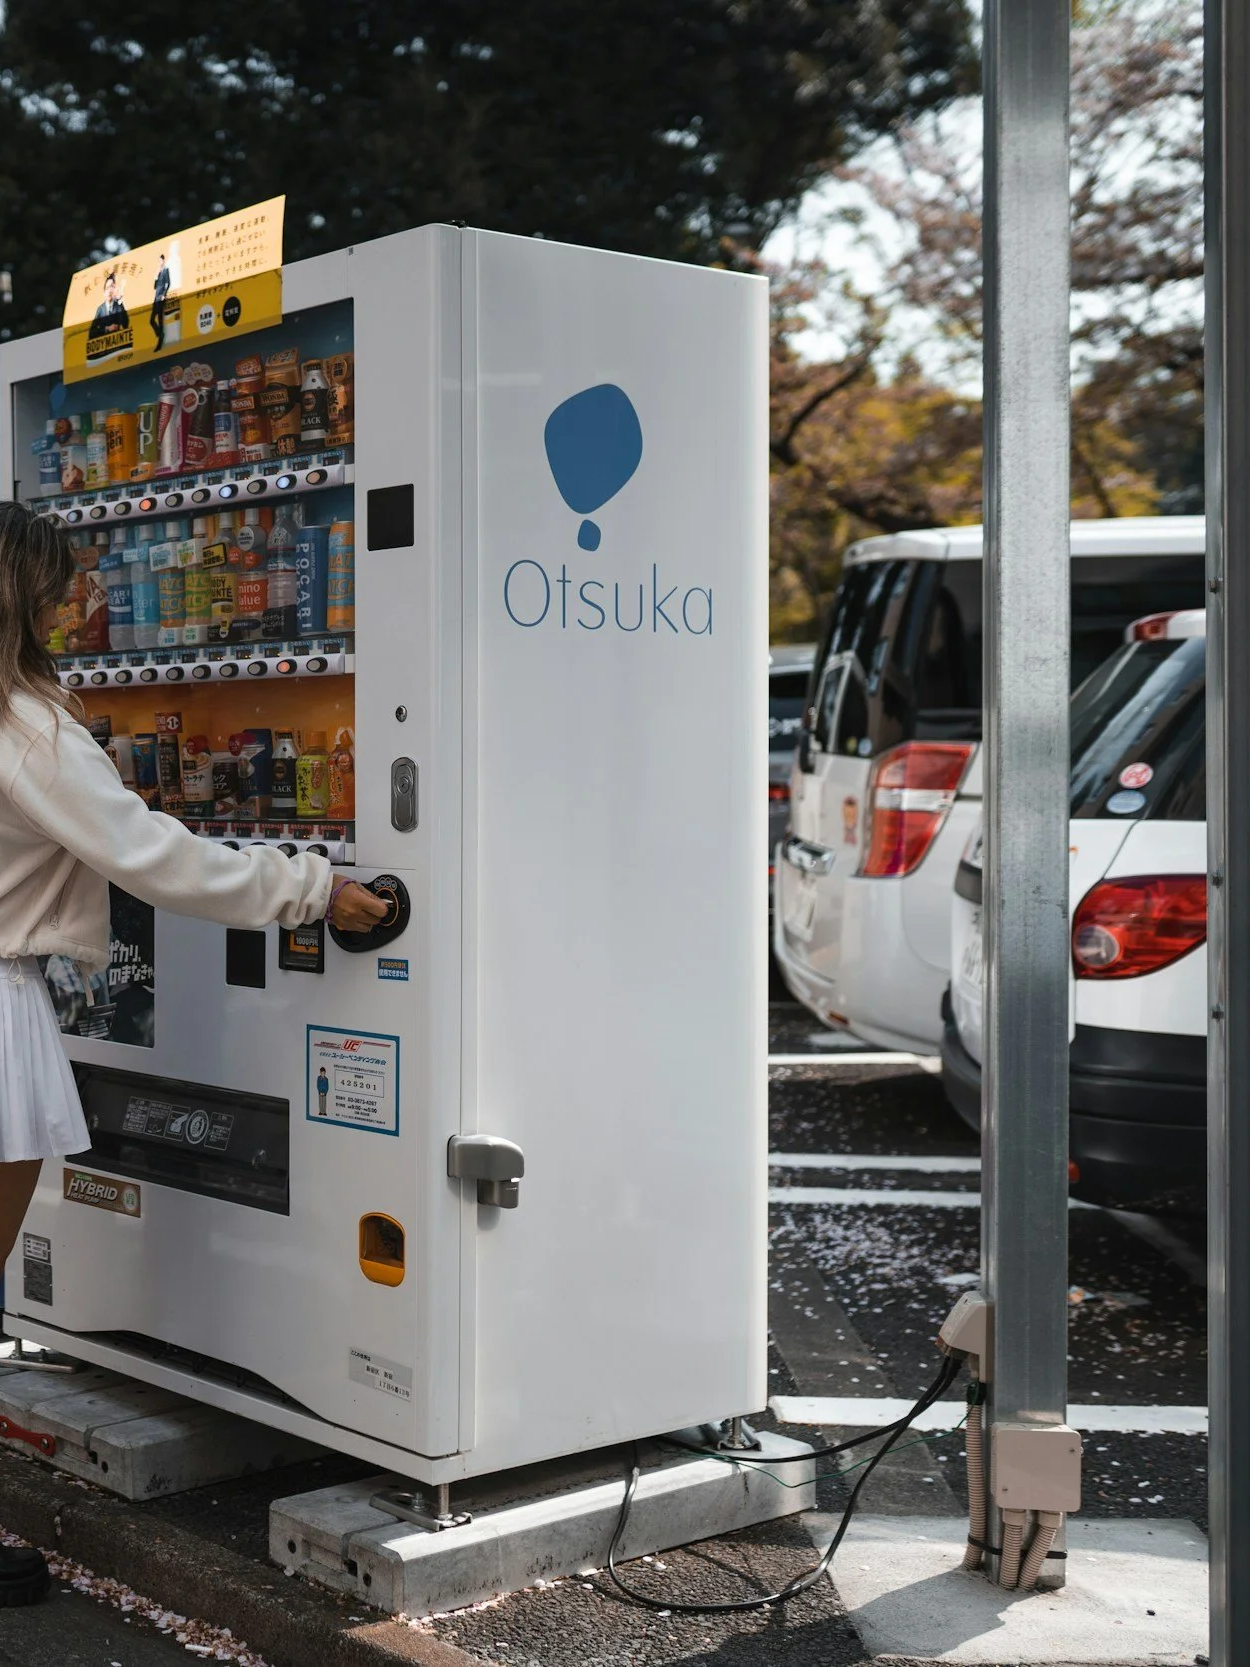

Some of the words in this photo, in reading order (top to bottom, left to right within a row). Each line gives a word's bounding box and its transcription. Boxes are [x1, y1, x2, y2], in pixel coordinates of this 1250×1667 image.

[299, 543, 313, 628] POCARI
[504, 559, 713, 635] Otsuka
[343, 1039, 360, 1051] UC
[67, 1177, 118, 1201] HYBRID
